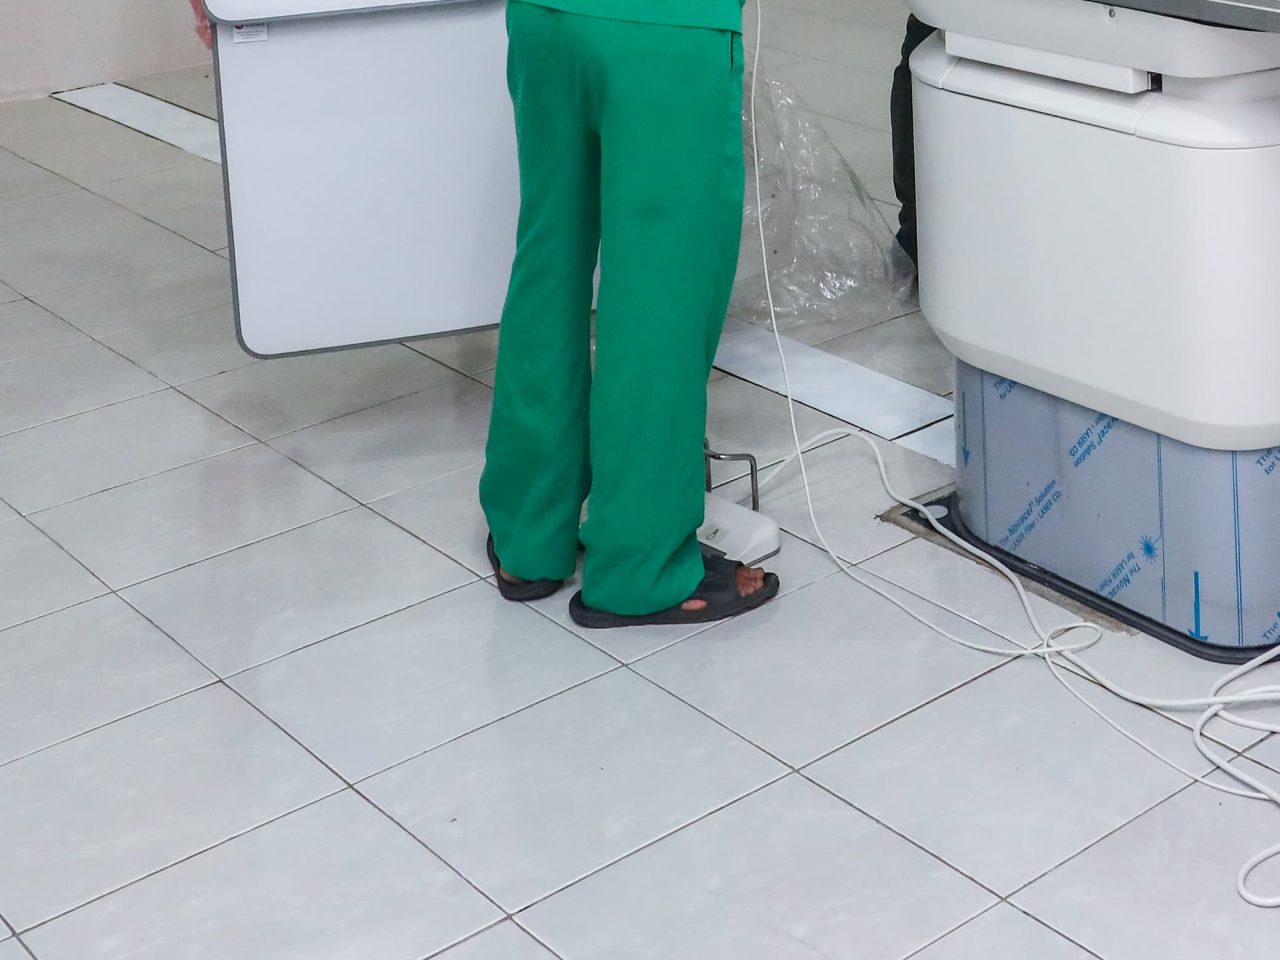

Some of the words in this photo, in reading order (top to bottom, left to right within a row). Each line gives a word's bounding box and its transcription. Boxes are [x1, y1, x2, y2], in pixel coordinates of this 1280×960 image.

[1256, 448, 1273, 466] The
[1264, 460, 1276, 475] for
[1262, 622, 1279, 640] The
